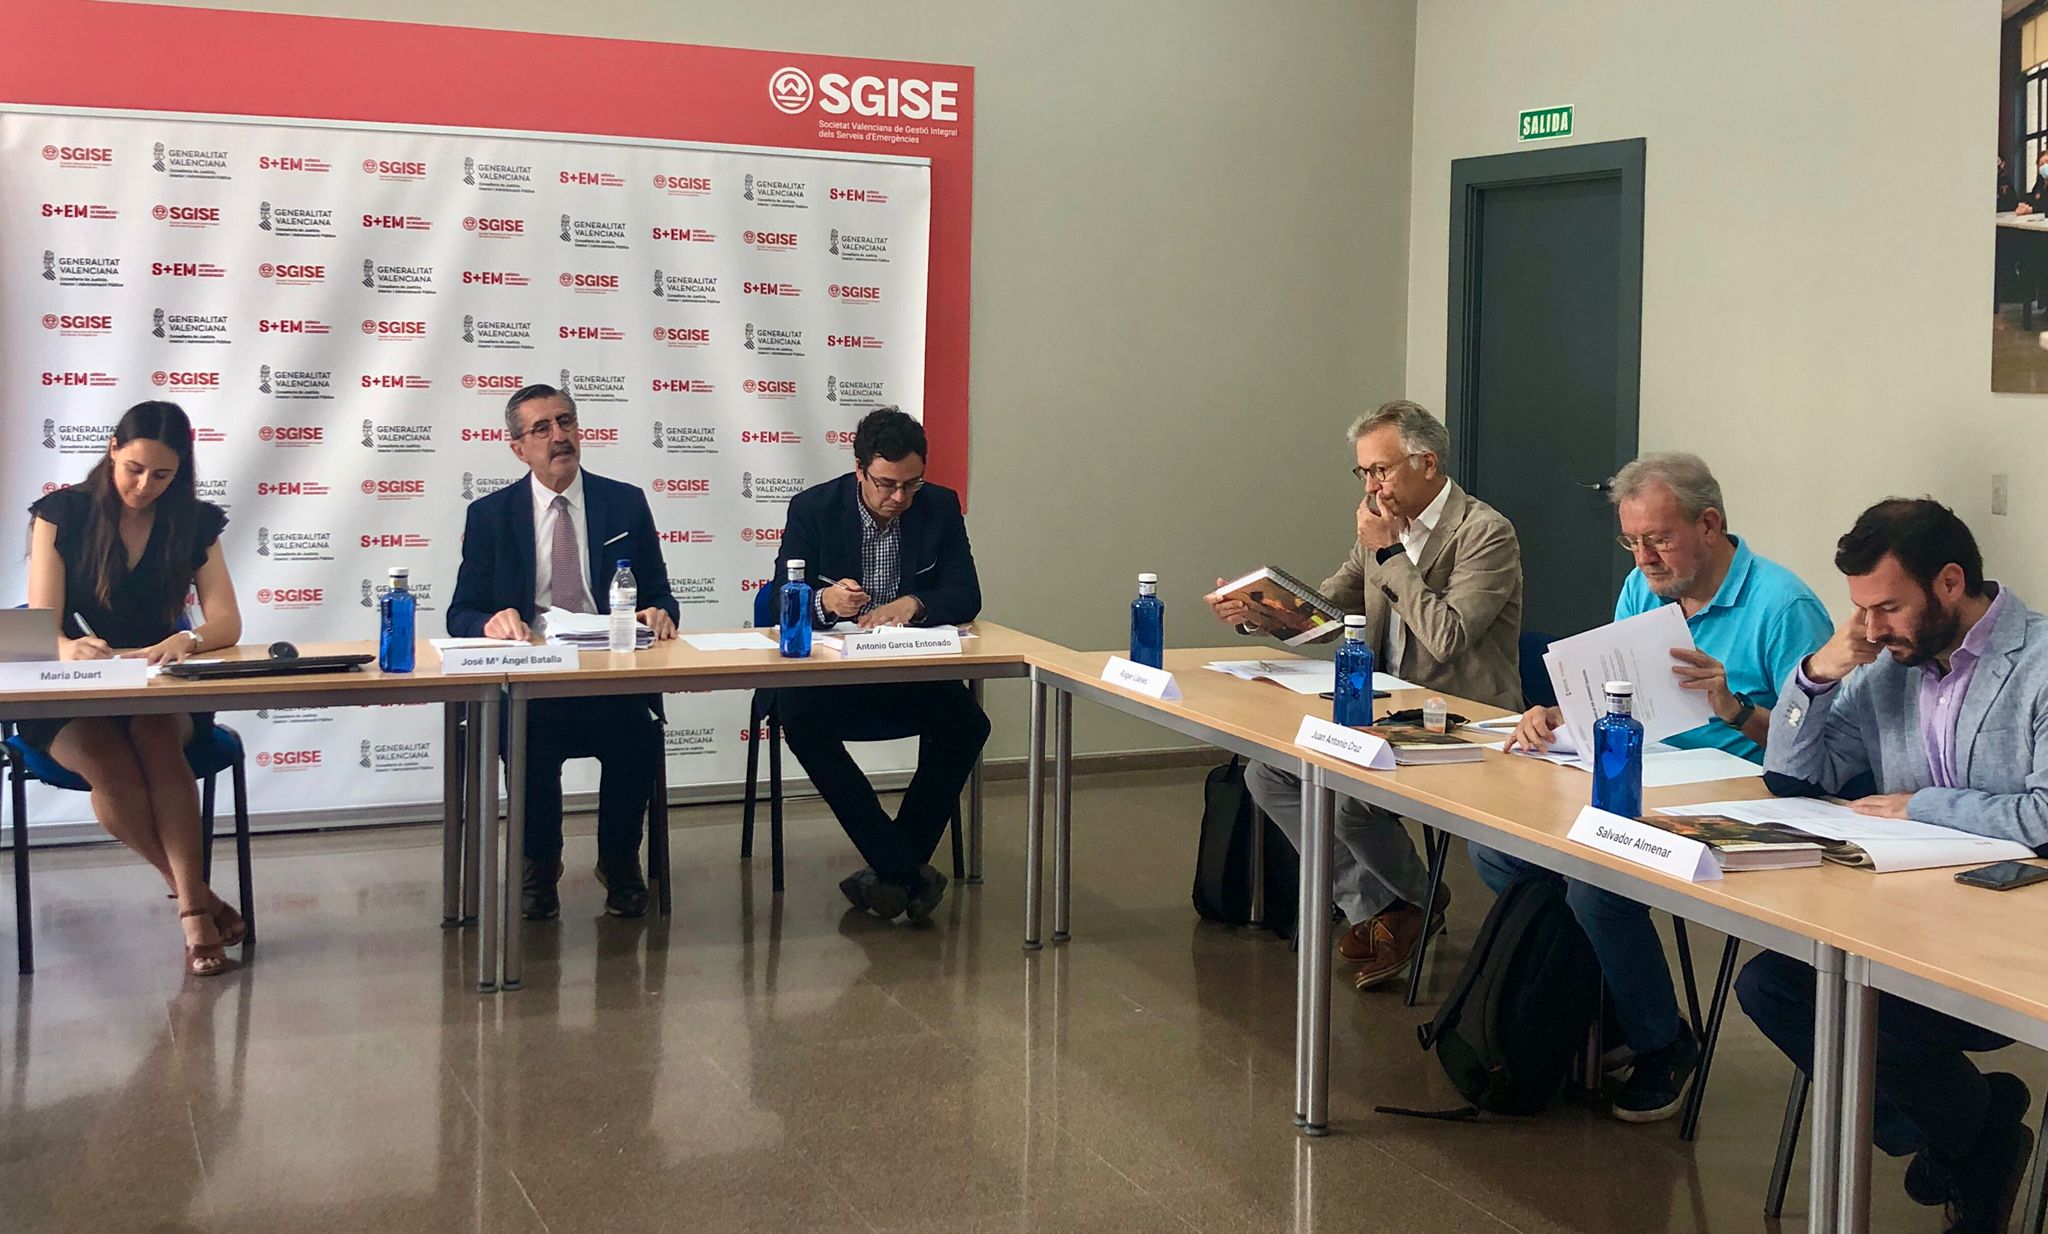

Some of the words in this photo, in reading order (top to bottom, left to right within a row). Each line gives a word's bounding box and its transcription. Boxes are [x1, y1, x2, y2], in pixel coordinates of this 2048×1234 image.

[819, 74, 958, 120] SGISE
[818, 120, 850, 130] Societat
[852, 122, 892, 132] Valenciana
[905, 126, 928, 134] Gestió
[930, 127, 958, 136] Integral
[1523, 112, 1568, 135] SALIDA
[818, 130, 834, 138] dels
[836, 132, 864, 140] Serveis
[865, 133, 919, 143] d'Emergències
[61, 147, 112, 161] SGISE
[169, 150, 228, 159] GENERALITAT
[170, 158, 226, 167] VALENCIANA
[260, 157, 302, 170] S+EM
[379, 161, 426, 175] SGISE
[478, 164, 531, 173] GENERALITAT
[479, 173, 530, 181] VALENCIANA
[560, 172, 599, 185] S+EM
[668, 177, 710, 190] SGISE
[757, 181, 805, 190] GENERALITAT
[758, 189, 804, 197] VALENCIANA
[830, 188, 865, 201] S+EM
[42, 204, 87, 218] S+EM
[170, 207, 219, 220] SGISE
[274, 208, 332, 218] GENERALITAT
[276, 217, 331, 226] VALENCIANA
[363, 215, 404, 228] S+EM
[478, 219, 523, 232] SGISE
[574, 221, 626, 230] GENERALITAT
[575, 229, 625, 238] VALENCIANA
[653, 228, 690, 240] S+EM
[757, 232, 797, 245] SGISE
[842, 235, 888, 244] GENERALITAT
[59, 258, 120, 266] GENERALITAT
[60, 266, 118, 274] VALENCIANA
[152, 263, 196, 276] S+EM
[276, 265, 324, 278] SGISE
[463, 272, 502, 284] S+EM
[575, 274, 618, 287] SGISE
[666, 277, 717, 285] GENERALITAT
[744, 282, 777, 295] S+EM
[841, 286, 879, 298] SGISE
[60, 316, 111, 328] SGISE
[168, 315, 227, 324] GENERALITAT
[169, 323, 226, 332] VALENCIANA
[260, 320, 302, 332] S+EM
[378, 321, 425, 333] SGISE
[477, 322, 531, 330] GENERALITAT
[560, 327, 598, 339] S+EM
[668, 329, 709, 341] SGISE
[757, 330, 802, 338] GENERALITAT
[758, 337, 801, 345] VALENCIANA
[828, 335, 861, 347] S+EM
[42, 373, 87, 385] S+EM
[170, 372, 219, 385] SGISE
[275, 371, 331, 380] GENERALITAT
[362, 376, 403, 387] S+EM
[276, 379, 330, 388] VALENCIANA
[478, 376, 523, 388] SGISE
[653, 380, 689, 392] S+EM
[758, 381, 796, 392] SGISE
[60, 434, 112, 442] VALENCIAN
[275, 428, 322, 440] SGISE
[462, 429, 502, 441] S+EM
[742, 431, 779, 443] S+EM
[378, 481, 424, 493] SGISE
[667, 480, 709, 491] SGISE
[755, 478, 805, 486] GENERALITAT
[258, 482, 300, 495] S+EM
[361, 535, 402, 547] S+EM
[376, 584, 432, 592] GEALITAT
[275, 589, 322, 602] SGISE
[856, 641, 886, 650] Antonio
[915, 639, 951, 648] Entonado
[461, 656, 484, 666] José
[486, 656, 499, 665] Mª
[502, 654, 528, 666] Ángel
[531, 654, 562, 664] Batalla
[74, 669, 102, 680] Duart
[1312, 730, 1325, 741] Juan
[1326, 735, 1348, 748] Antonio
[1348, 742, 1362, 752] Cruz
[375, 743, 430, 752] GENERALITAT
[274, 750, 321, 764] SGISE
[376, 751, 429, 760] VALENCIANA
[1596, 826, 1633, 846] Salvador
[1634, 838, 1672, 858] Almenar
